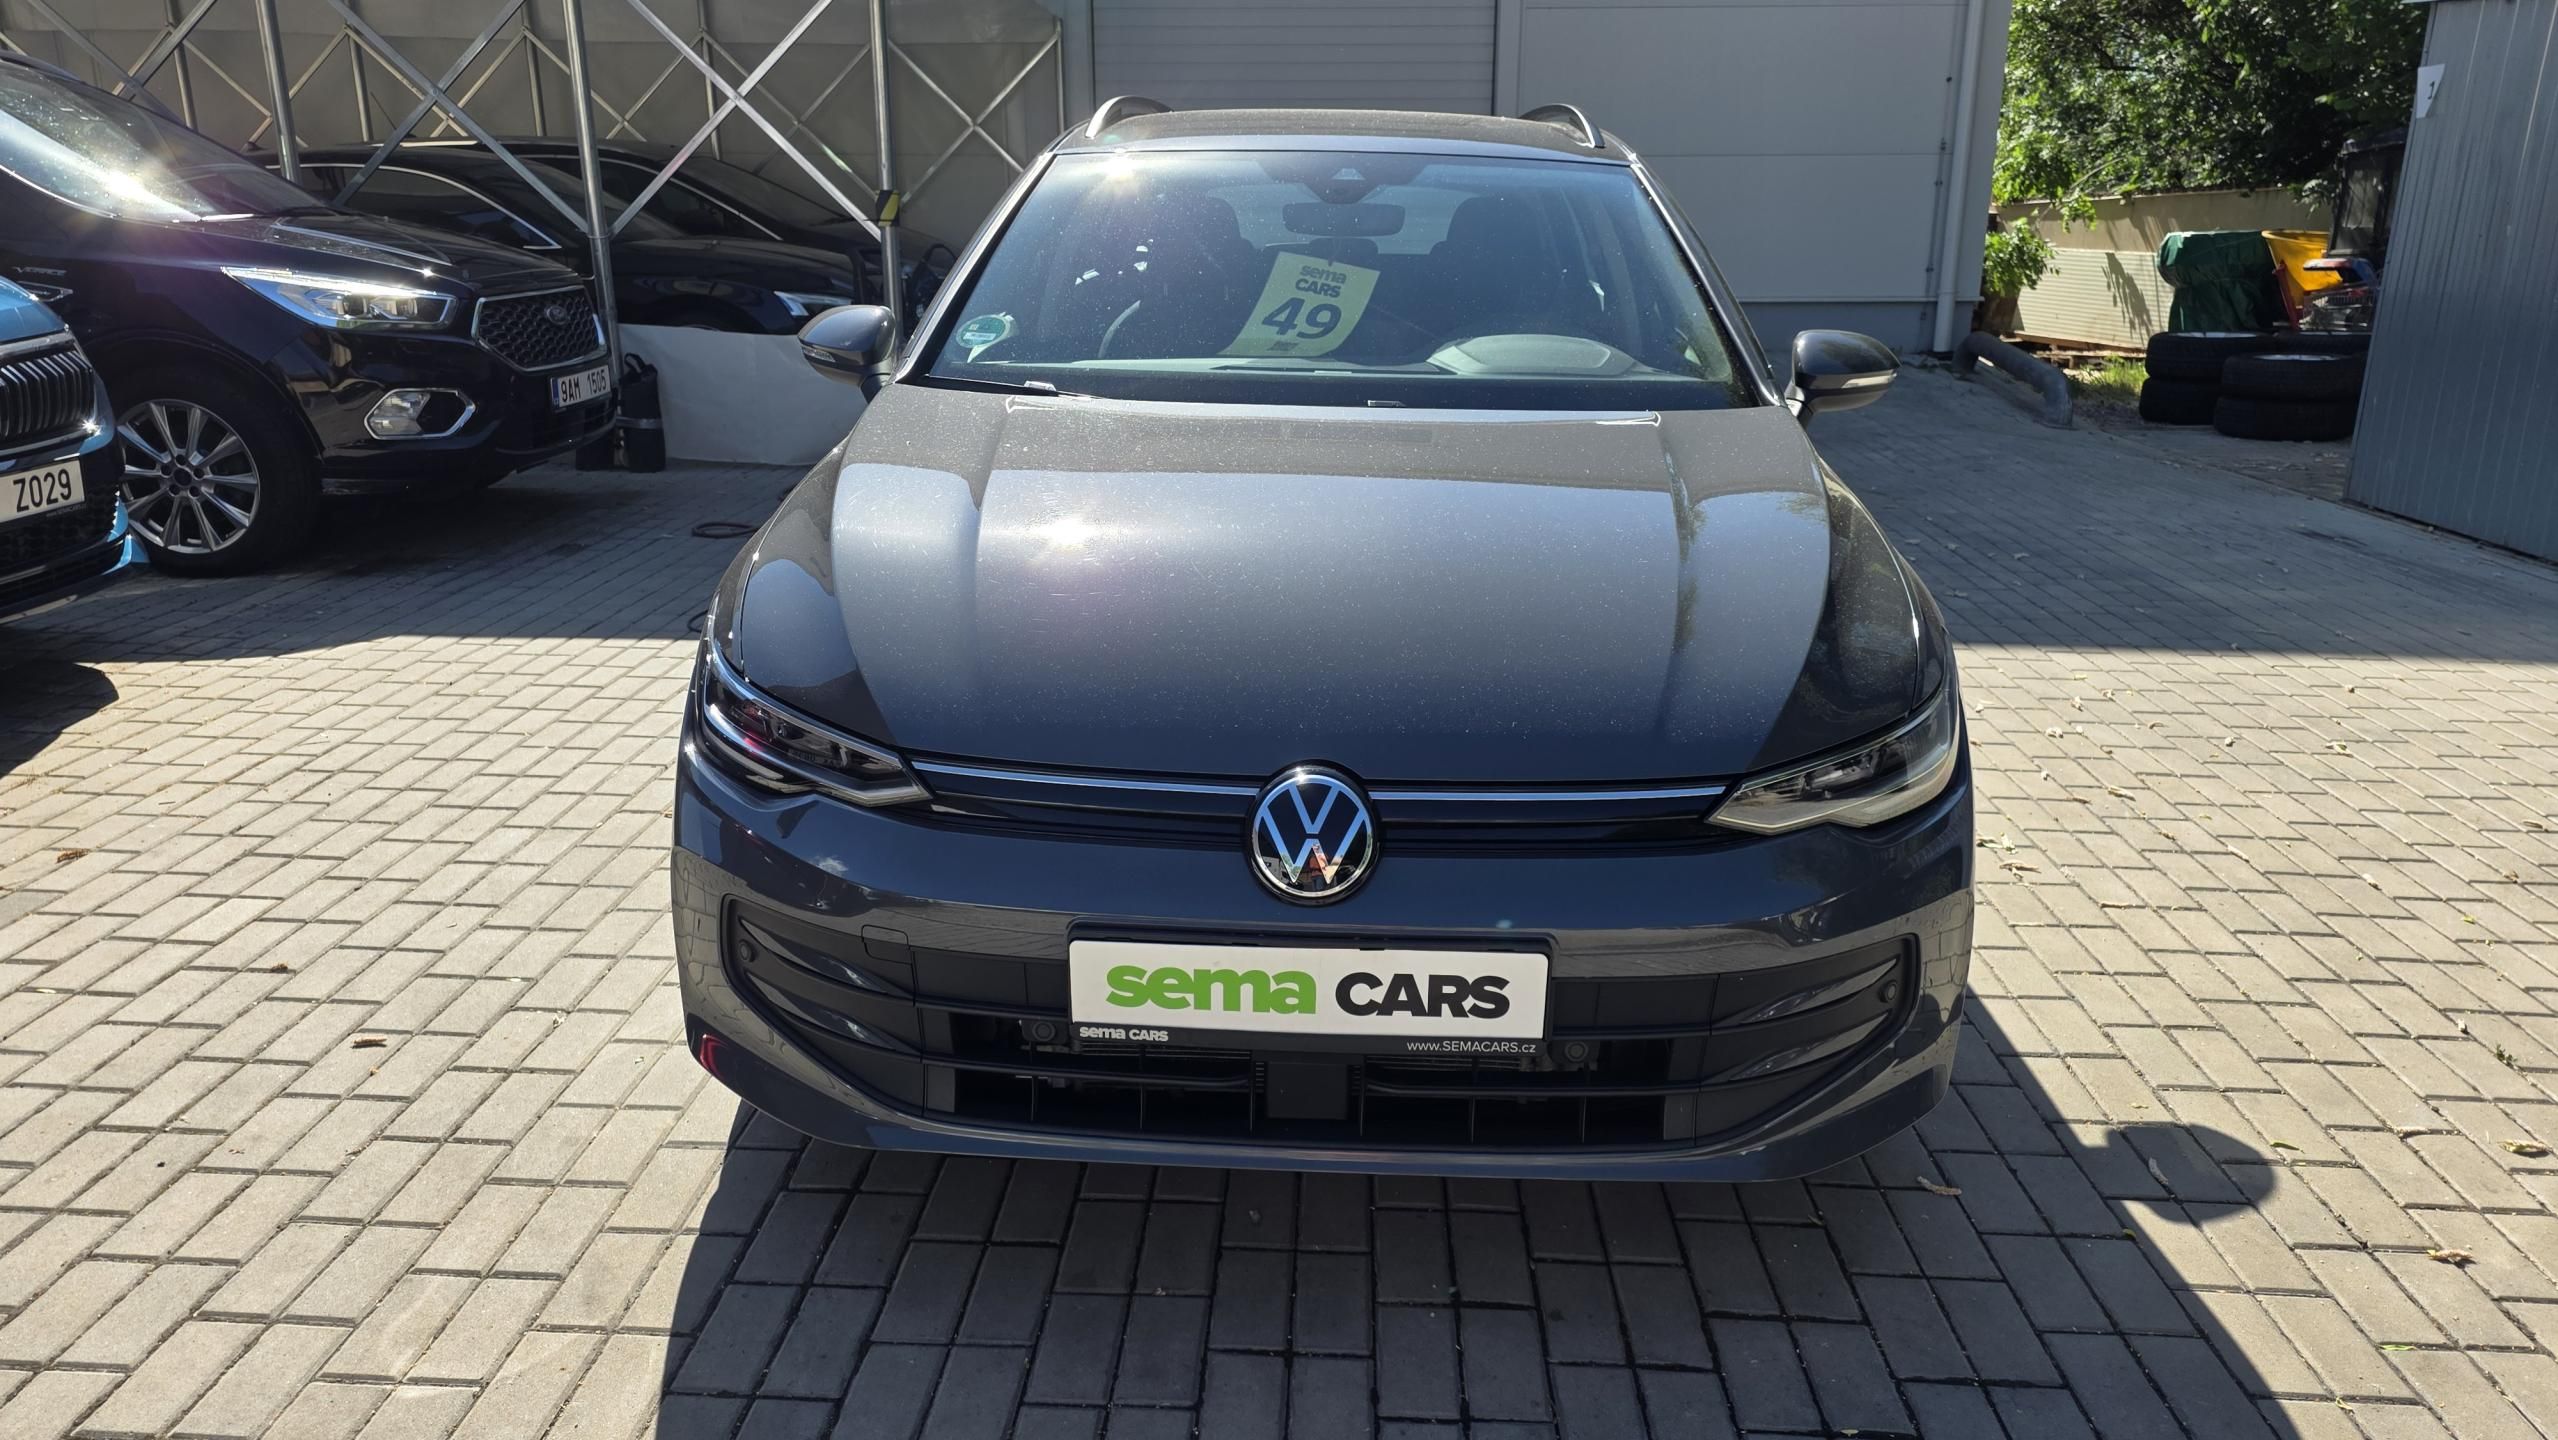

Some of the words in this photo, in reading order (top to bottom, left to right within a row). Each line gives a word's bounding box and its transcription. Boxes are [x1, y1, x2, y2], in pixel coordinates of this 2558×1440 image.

[1300, 265, 1347, 284] sema
[1295, 278, 1342, 299] CARS
[1261, 296, 1343, 339] 49
[587, 369, 607, 395] 1505
[12, 468, 72, 513] Z029
[1105, 965, 1317, 1015] sema
[1334, 971, 1511, 1019] CARS
[1079, 1026, 1126, 1040] sema
[1128, 1029, 1169, 1042] CARS
[1406, 1040, 1537, 1054] www.SEMACARS.cz
